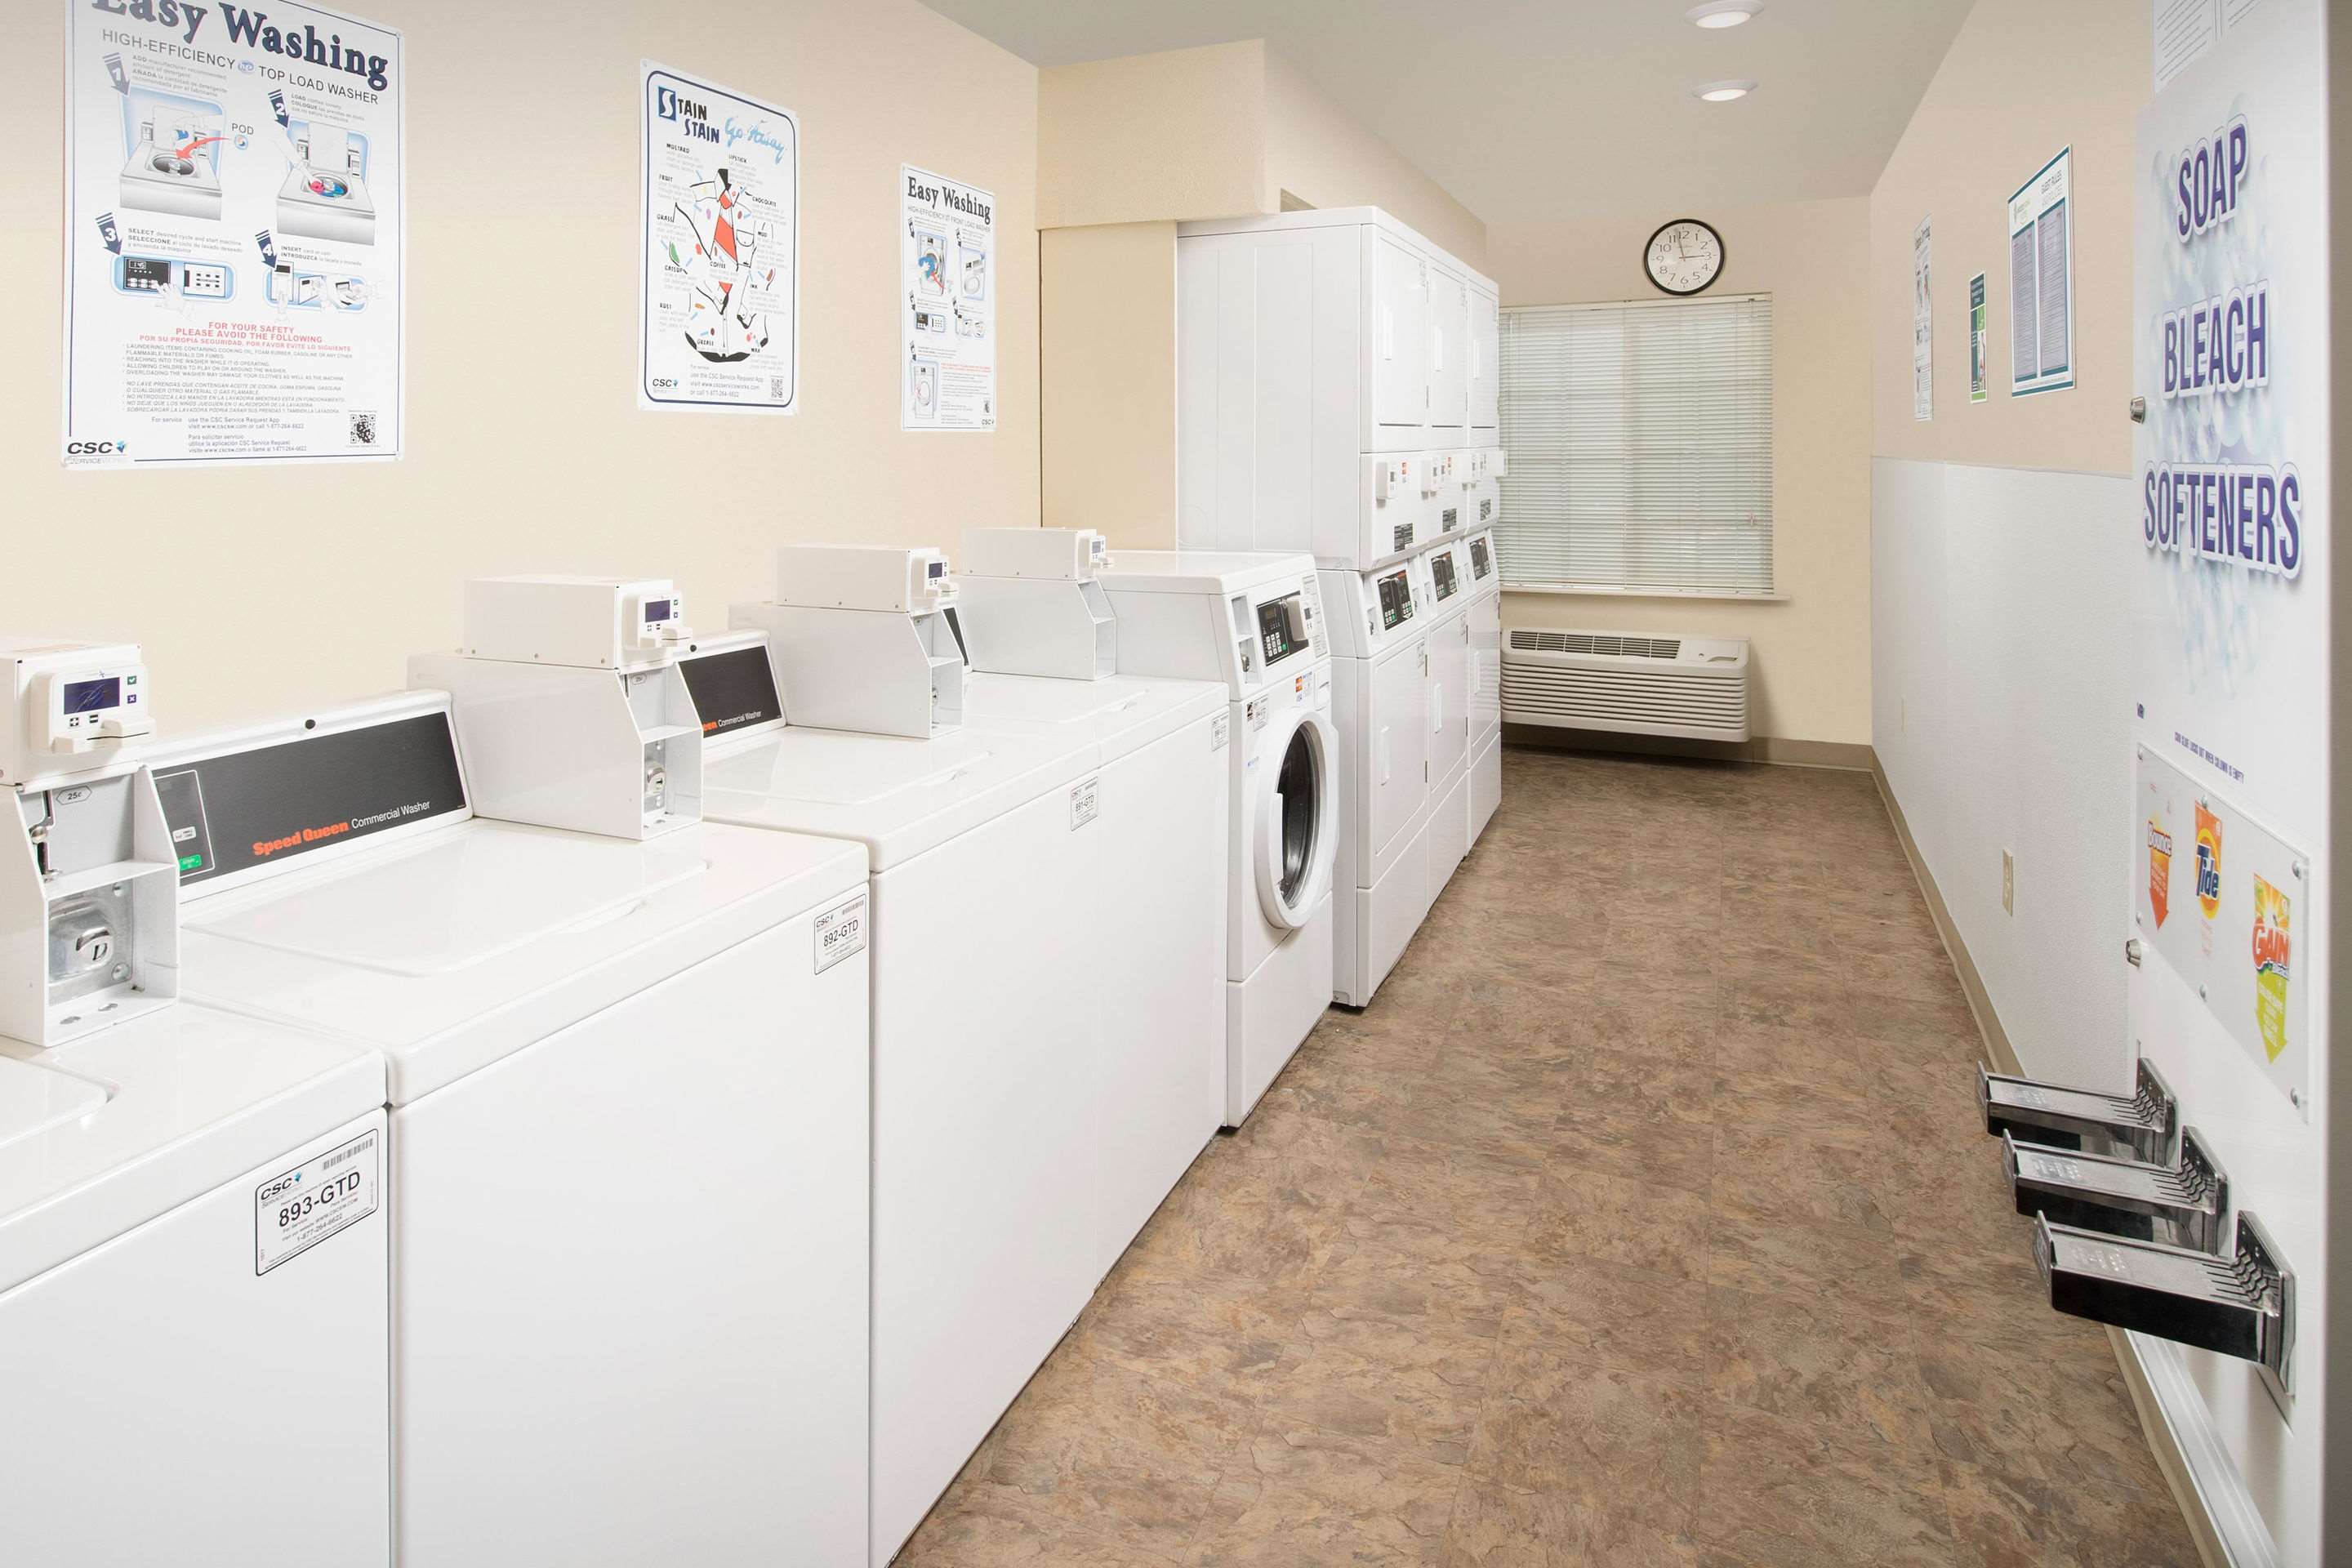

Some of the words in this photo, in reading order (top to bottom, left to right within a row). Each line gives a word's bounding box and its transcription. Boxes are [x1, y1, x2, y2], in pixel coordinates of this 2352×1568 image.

[219, 2, 389, 91] Washing
[102, 29, 236, 70] HIGH-EFFICIENCY
[258, 65, 286, 81] TOP
[289, 74, 324, 91] LOAD
[327, 82, 378, 105] WASHER
[113, 68, 121, 81] 1
[275, 103, 284, 116] 2
[658, 86, 707, 121] STAIN
[231, 122, 254, 136] POD
[684, 118, 719, 144] STAIN
[724, 117, 743, 148] Go
[659, 174, 673, 182] FRUIT
[2178, 120, 2247, 241] SOAP
[907, 176, 939, 209] Easy
[942, 185, 991, 225] Washing
[657, 214, 673, 223] GRASS
[105, 227, 116, 242] 3
[128, 235, 171, 245] SELECCIONE
[1668, 234, 1676, 243] 11
[1678, 230, 1690, 239] 12
[263, 243, 272, 256] 4
[1659, 243, 1672, 252] 10
[1700, 241, 1708, 250] 2
[1656, 255, 1664, 264] 9
[1704, 252, 1712, 260] 3
[1659, 265, 1668, 274] 8
[1692, 272, 1700, 280] 5
[1668, 273, 1676, 282] 7
[1680, 276, 1688, 285] 6
[209, 321, 229, 331] FOR
[231, 323, 257, 333] YOUR
[260, 324, 294, 334] SAFETY
[176, 327, 214, 337] PLEASE
[216, 329, 247, 339] AVOID
[249, 332, 268, 341] THE
[270, 332, 323, 344] FOLLOWING
[2163, 287, 2268, 395] BLEACH
[170, 336, 198, 344] PROPIA
[262, 341, 285, 349] FAVOR
[652, 378, 672, 387] CSC
[67, 442, 114, 455] CSC
[2145, 466, 2300, 574] SOFTENERS
[718, 715, 744, 728] Commercial
[745, 710, 762, 720] Washer
[253, 831, 302, 856] Speed
[303, 820, 349, 842] Queen
[351, 808, 400, 830] Commercial
[401, 798, 430, 819] Washer
[2148, 822, 2172, 857] Bounce
[2196, 844, 2220, 900] Tide
[816, 915, 830, 929] CSC
[823, 919, 858, 947] 892-GTD
[2252, 921, 2292, 969] GAIN
[261, 1177, 292, 1200] CSC
[278, 1171, 360, 1227] 893-GTD
